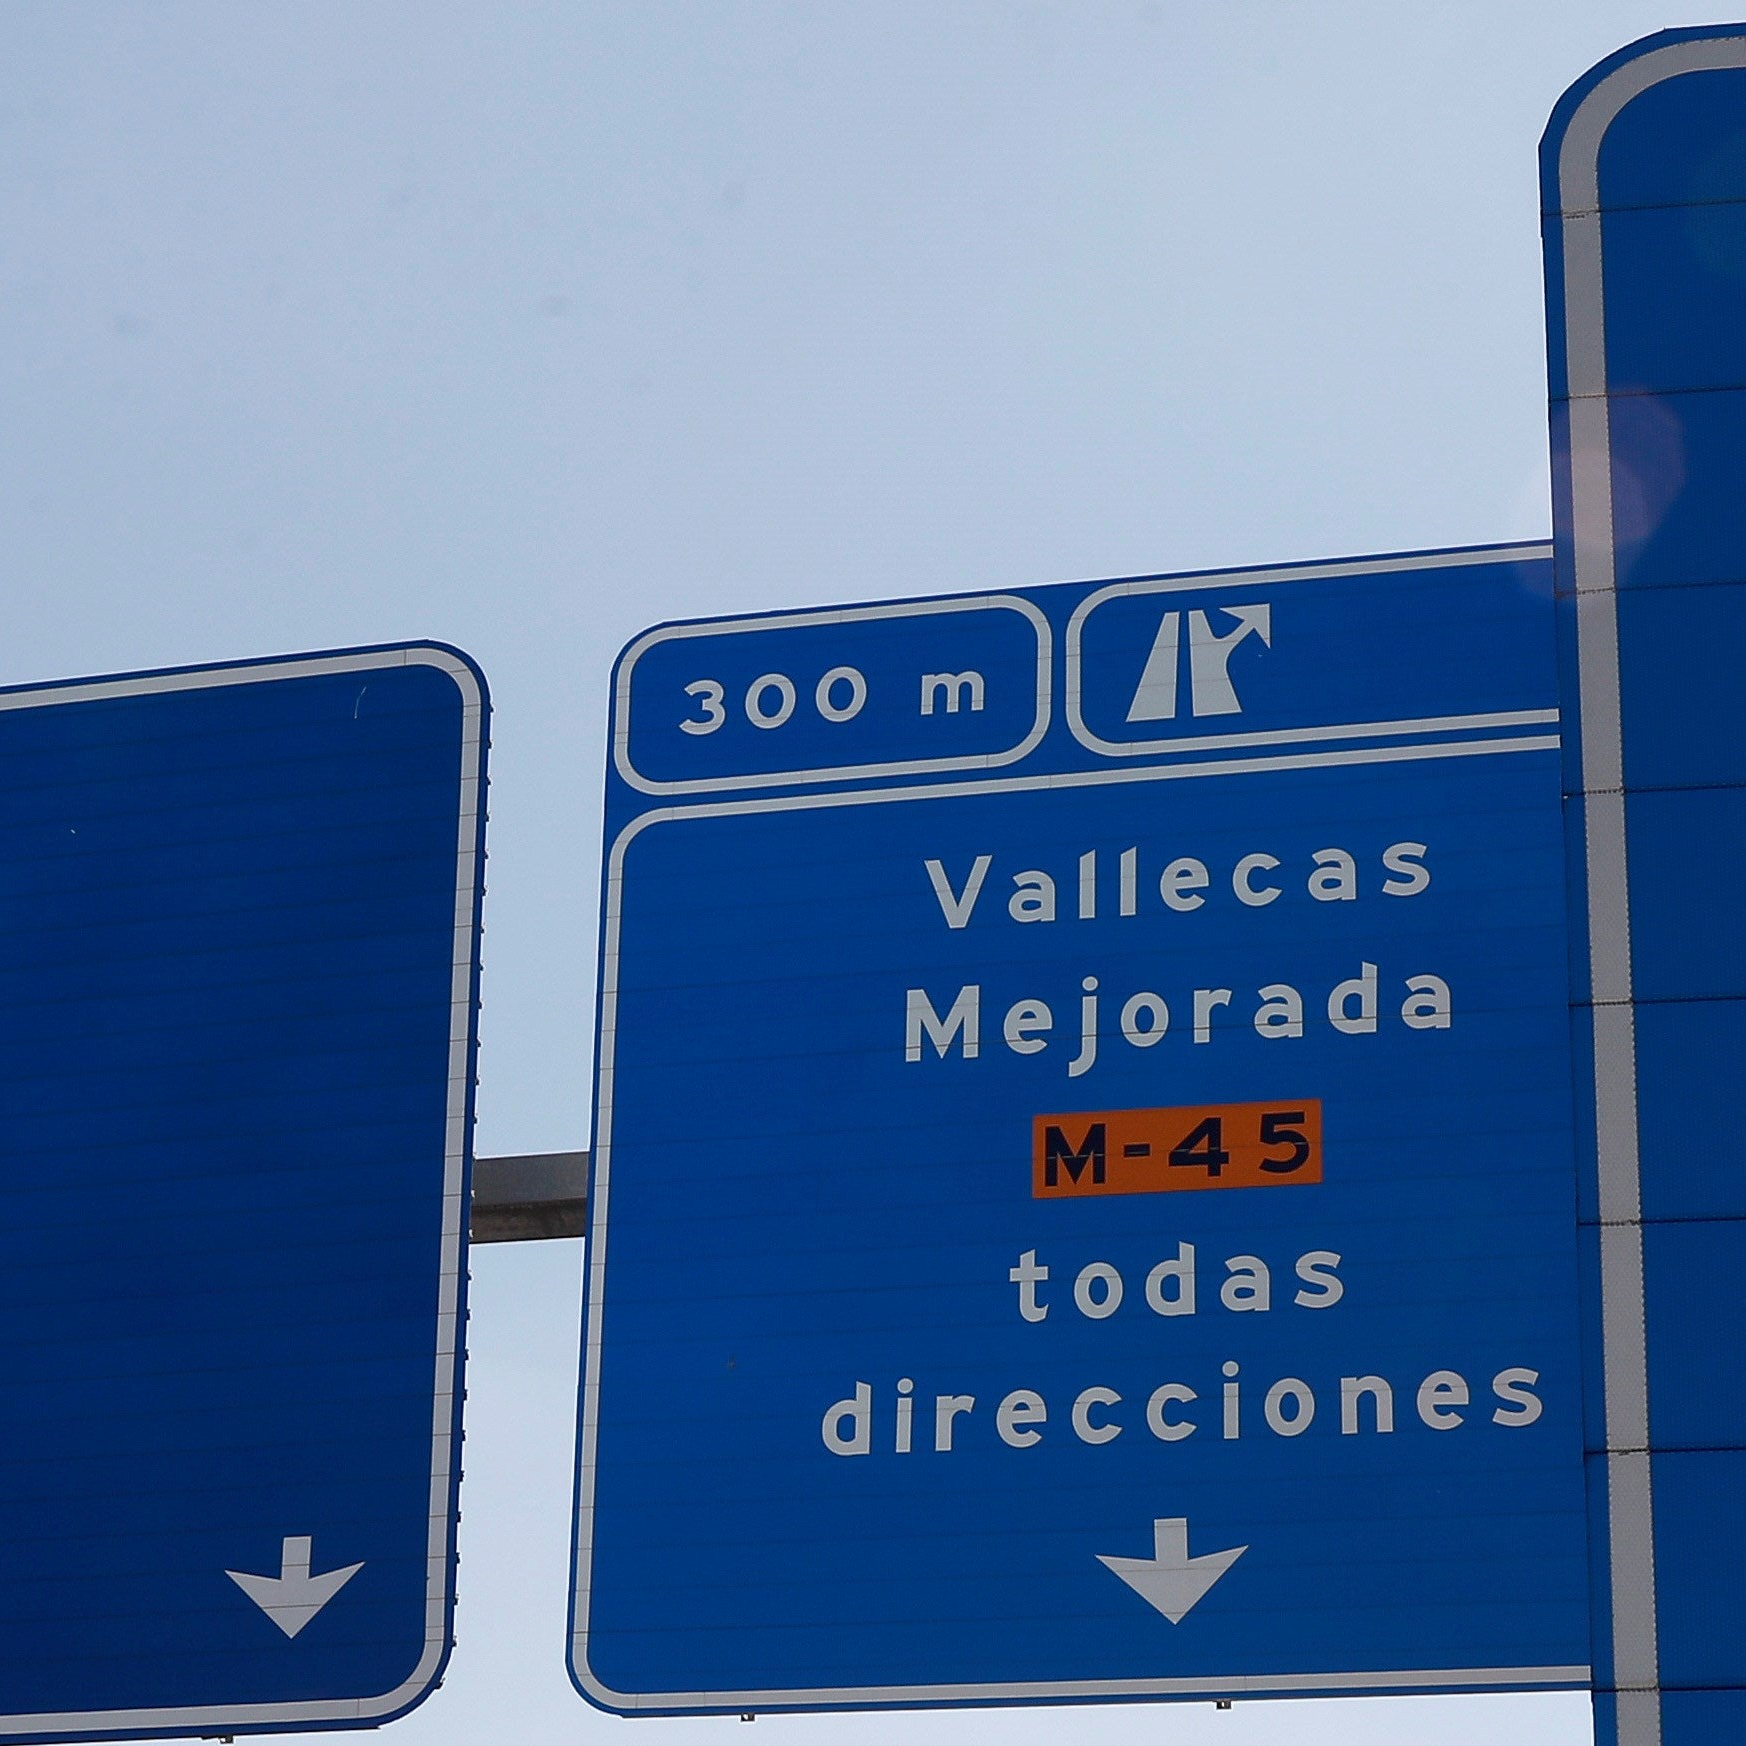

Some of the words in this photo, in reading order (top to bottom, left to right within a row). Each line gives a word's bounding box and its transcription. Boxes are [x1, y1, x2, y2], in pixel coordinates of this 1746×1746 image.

[678, 666, 867, 736] 300
[920, 670, 985, 716] m
[924, 842, 1430, 929] Vallecas
[905, 961, 1451, 1078] Mejorada
[1044, 1110, 1310, 1188] M-45
[1009, 1241, 1344, 1323] todas
[821, 1360, 1543, 1456] direcciones
